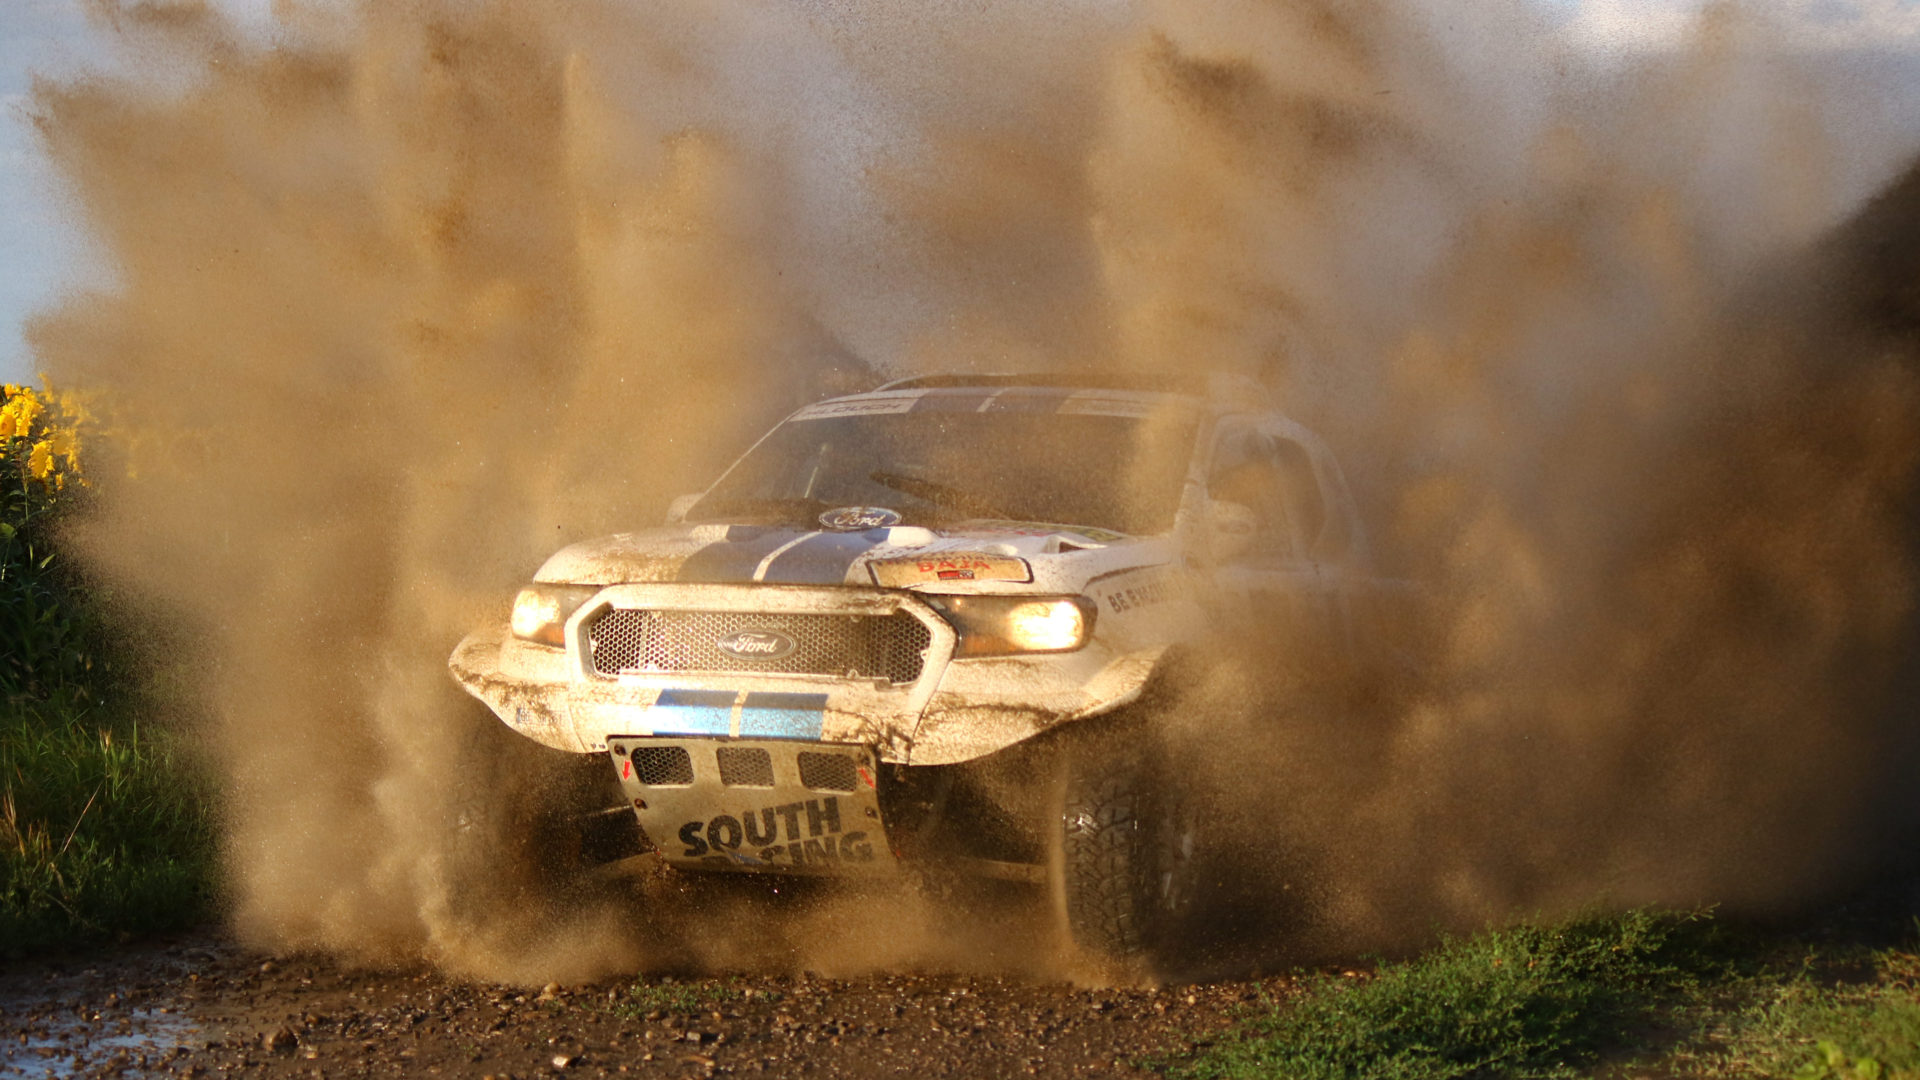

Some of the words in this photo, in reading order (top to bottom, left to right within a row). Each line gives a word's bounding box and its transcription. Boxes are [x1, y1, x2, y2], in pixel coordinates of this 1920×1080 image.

[834, 511, 887, 526] Ford
[917, 560, 991, 573] BAJA
[734, 633, 778, 653] Ford
[678, 797, 841, 857] SOUTH
[701, 831, 873, 867] CING
